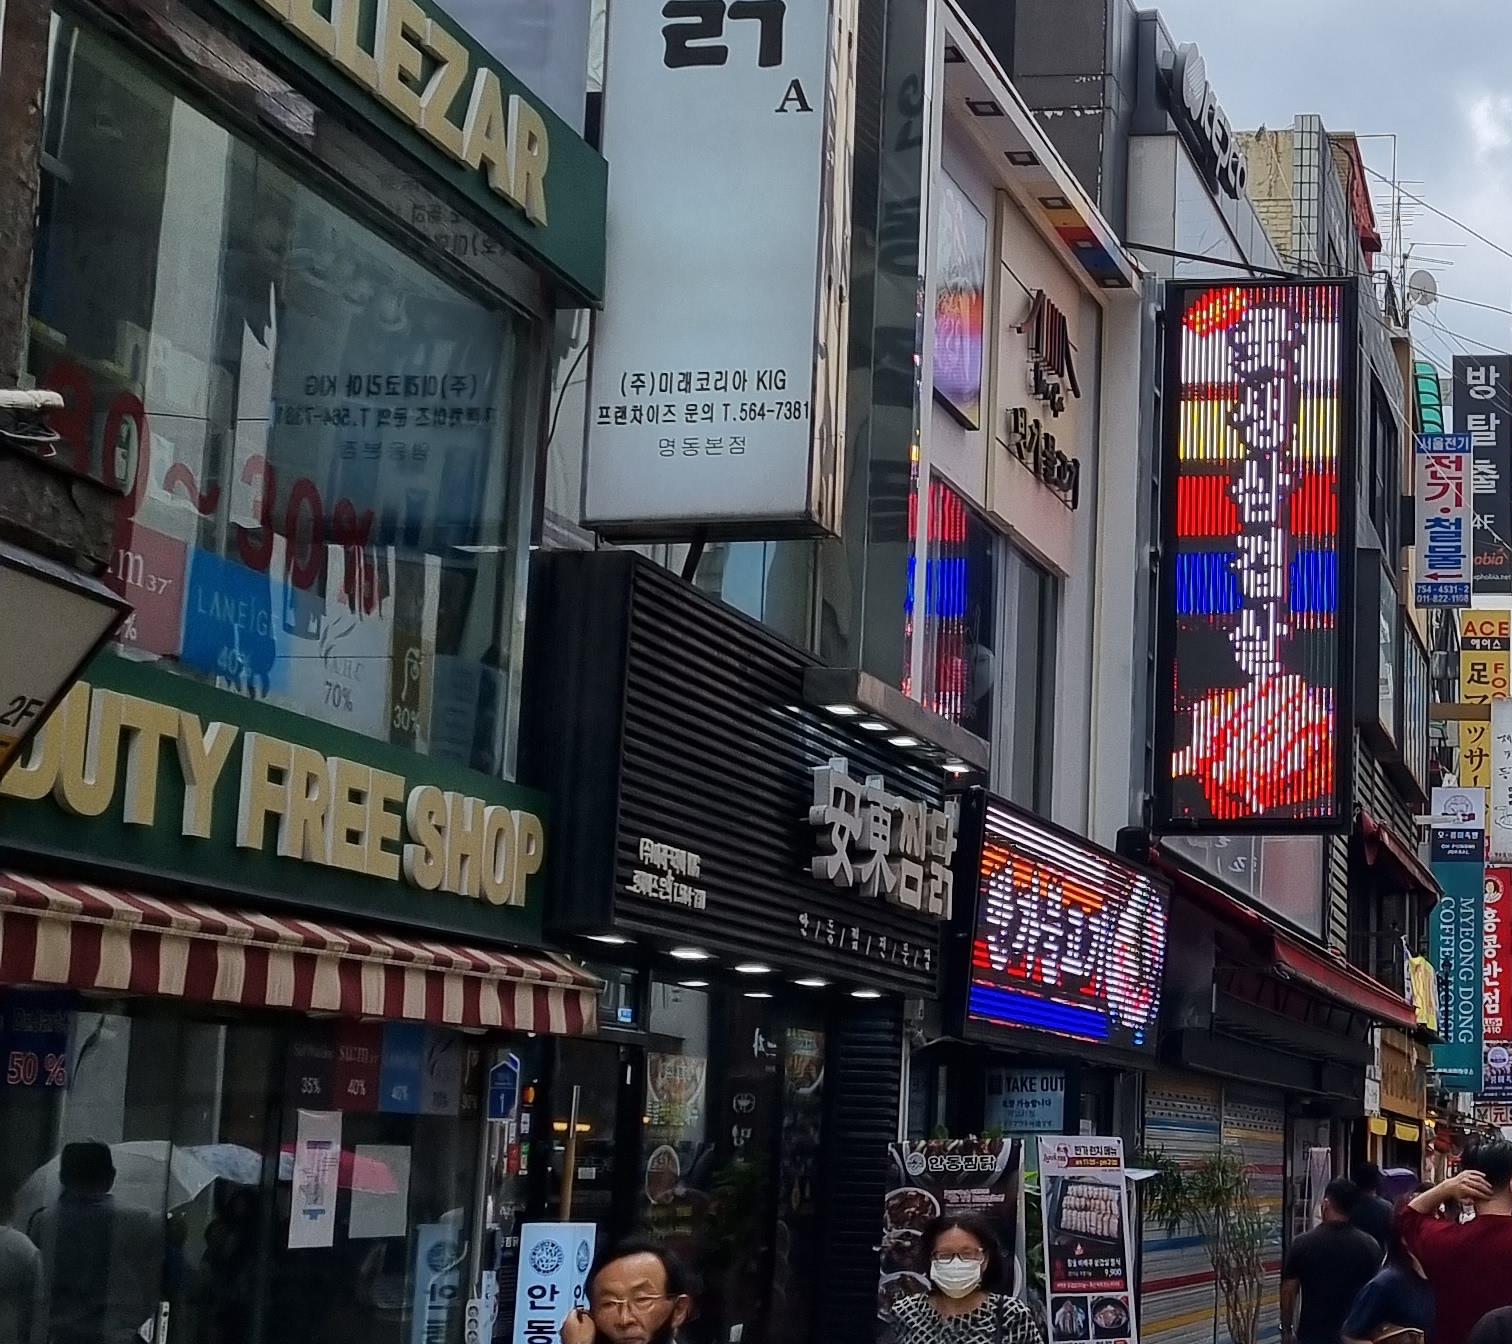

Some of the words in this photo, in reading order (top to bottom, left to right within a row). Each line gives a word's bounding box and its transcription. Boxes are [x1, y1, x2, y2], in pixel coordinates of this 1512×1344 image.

[756, 369, 787, 391] KIG
[684, 403, 714, 424] 문의
[1466, 365, 1500, 494] 방탈출
[658, 435, 746, 457] 명동본점
[1420, 436, 1470, 452] 서울전기
[1463, 620, 1510, 637] ACE
[1470, 638, 1502, 650] 에이스
[236, 731, 407, 881] FREE
[403, 783, 544, 908] SHOP
[1459, 896, 1475, 982] MYEONG
[1458, 989, 1475, 1045] DONG
[1006, 1076, 1038, 1093] TAKE
[1040, 1075, 1065, 1092] OUT
[928, 1154, 998, 1172] 안동찜닭
